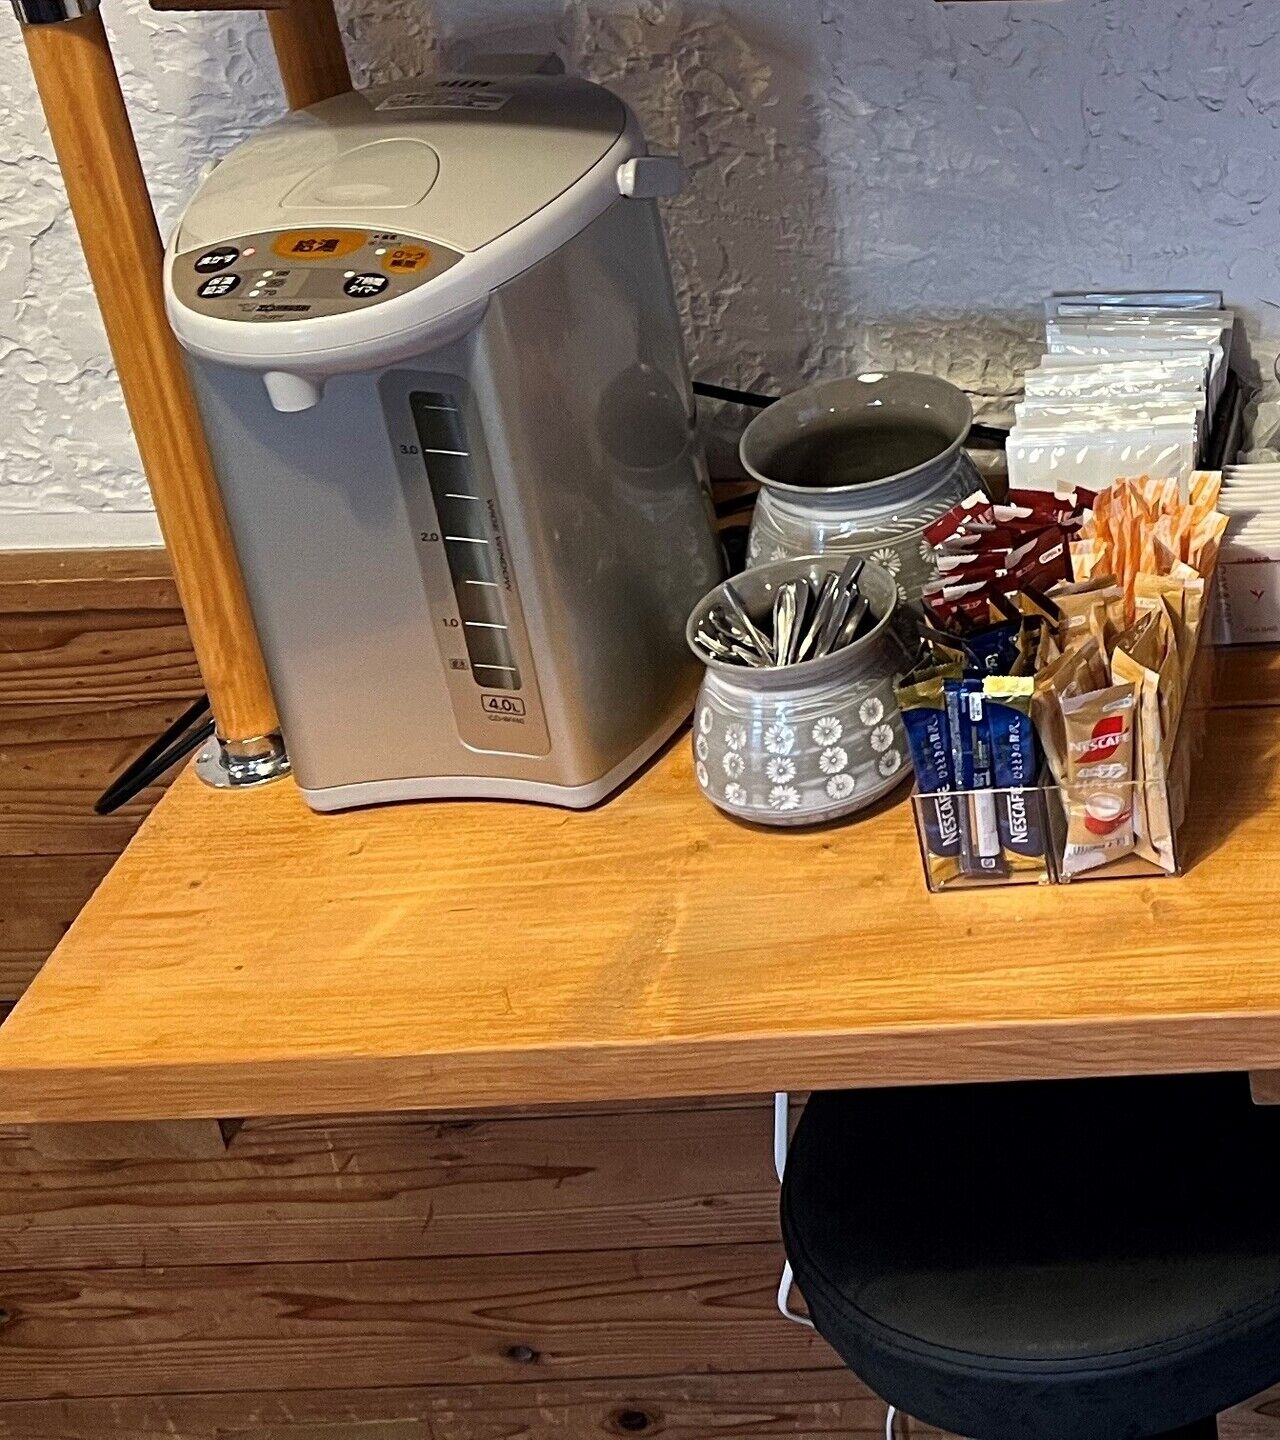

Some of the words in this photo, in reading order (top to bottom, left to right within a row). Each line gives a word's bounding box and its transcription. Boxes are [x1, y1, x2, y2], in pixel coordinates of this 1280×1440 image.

[291, 238, 341, 253] 給湯
[400, 444, 419, 456] 3.0
[420, 531, 440, 543] 2.0
[442, 618, 460, 628] 1.0
